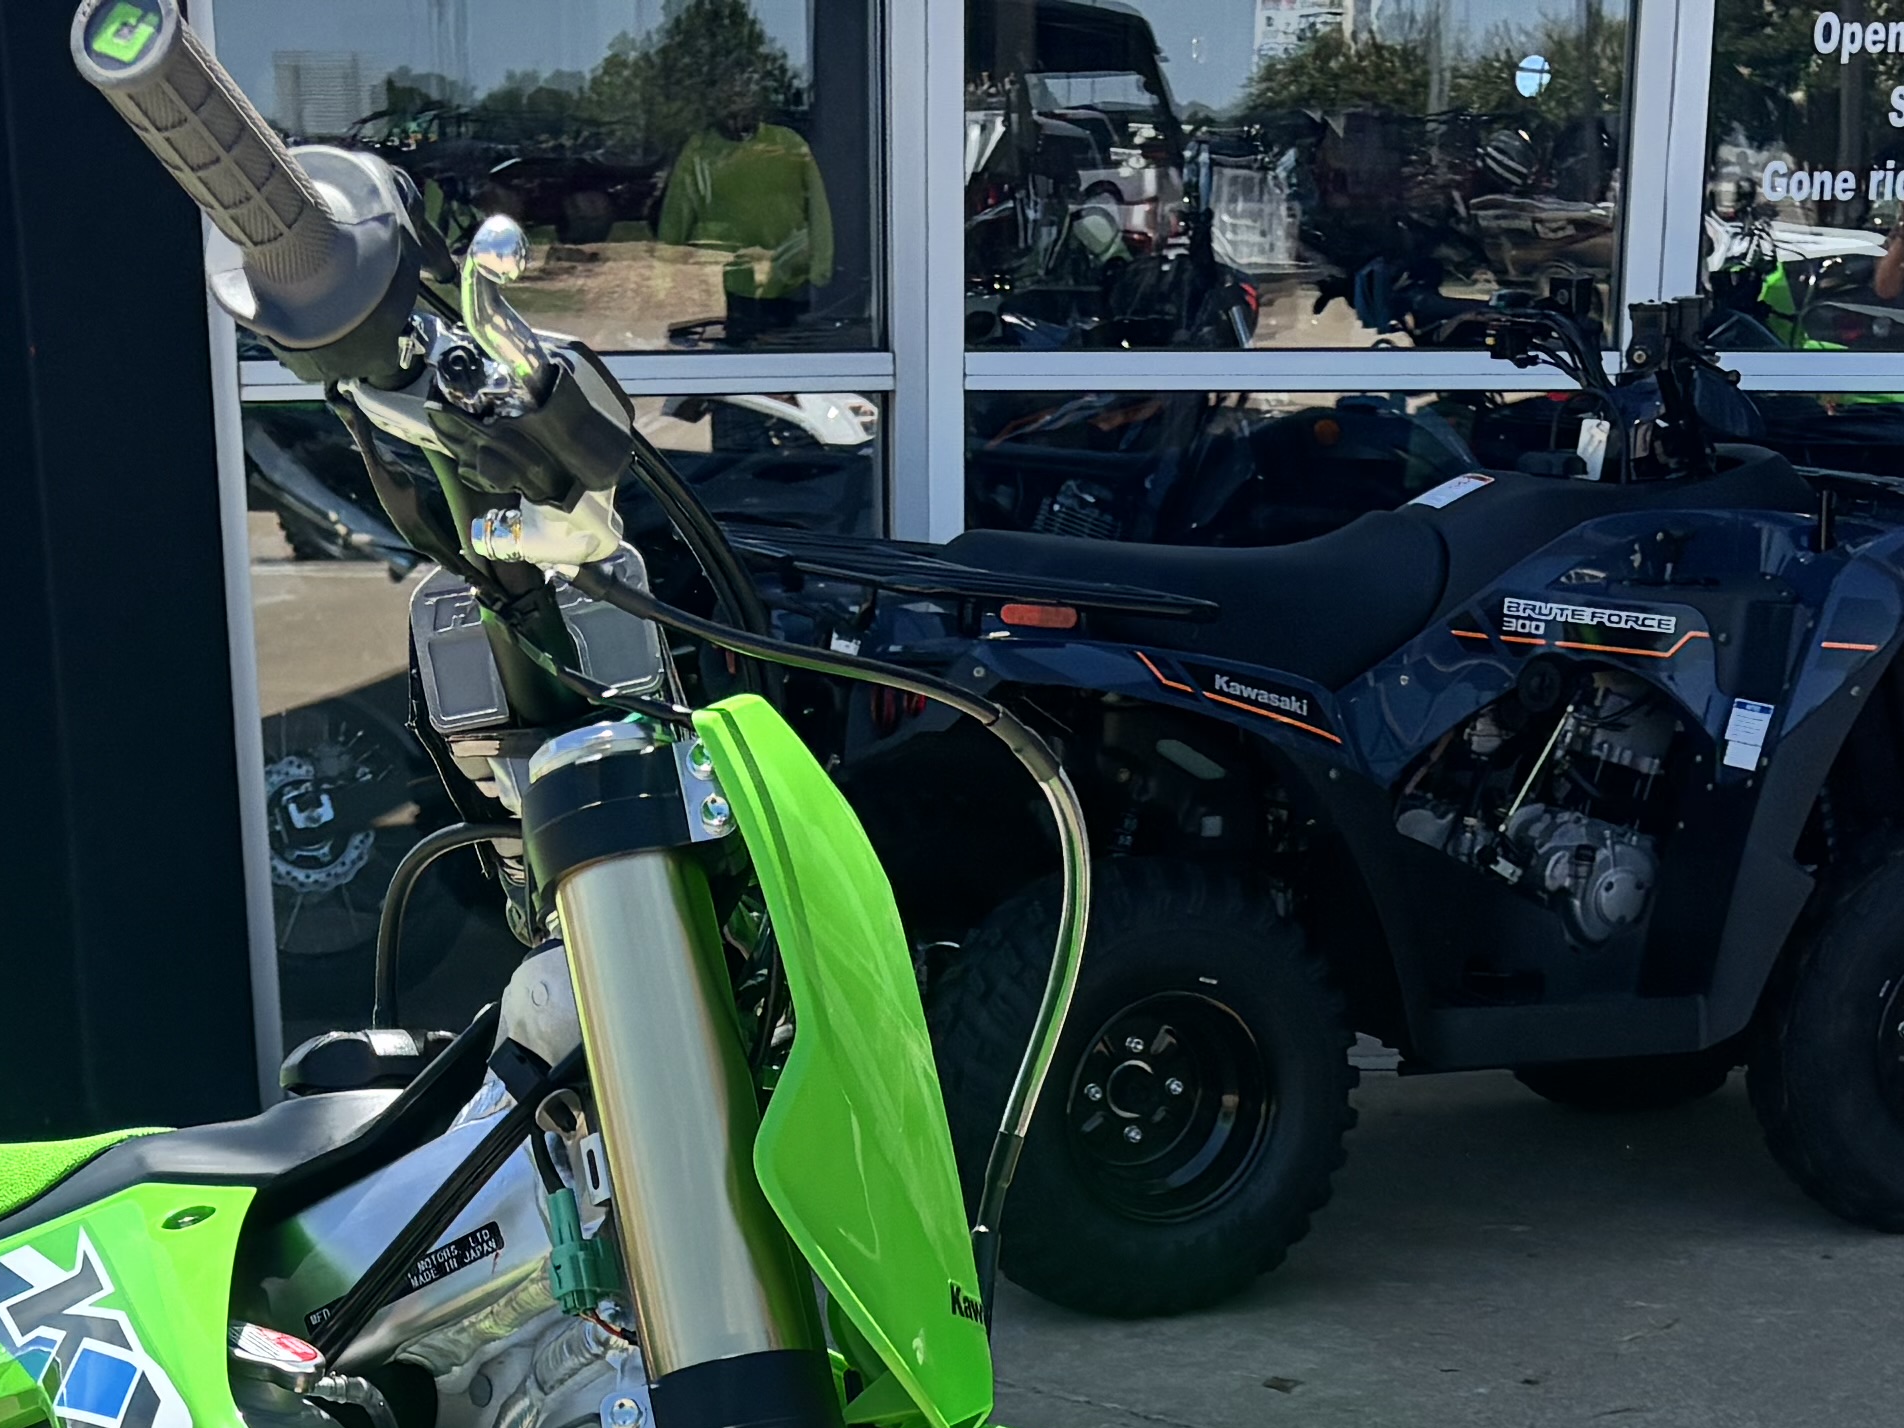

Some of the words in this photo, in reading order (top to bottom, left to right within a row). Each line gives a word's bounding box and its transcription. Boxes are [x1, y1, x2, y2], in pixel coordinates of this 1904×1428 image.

[1762, 160, 1855, 201] Gone
[1503, 597, 1586, 624] BRUTE
[1588, 607, 1676, 633] FORCE
[1503, 617, 1545, 635] 300
[1214, 674, 1308, 716] Kawasaki
[410, 1267, 438, 1289] MADE
[445, 1258, 458, 1273] IN
[464, 1238, 496, 1263] JAPAN
